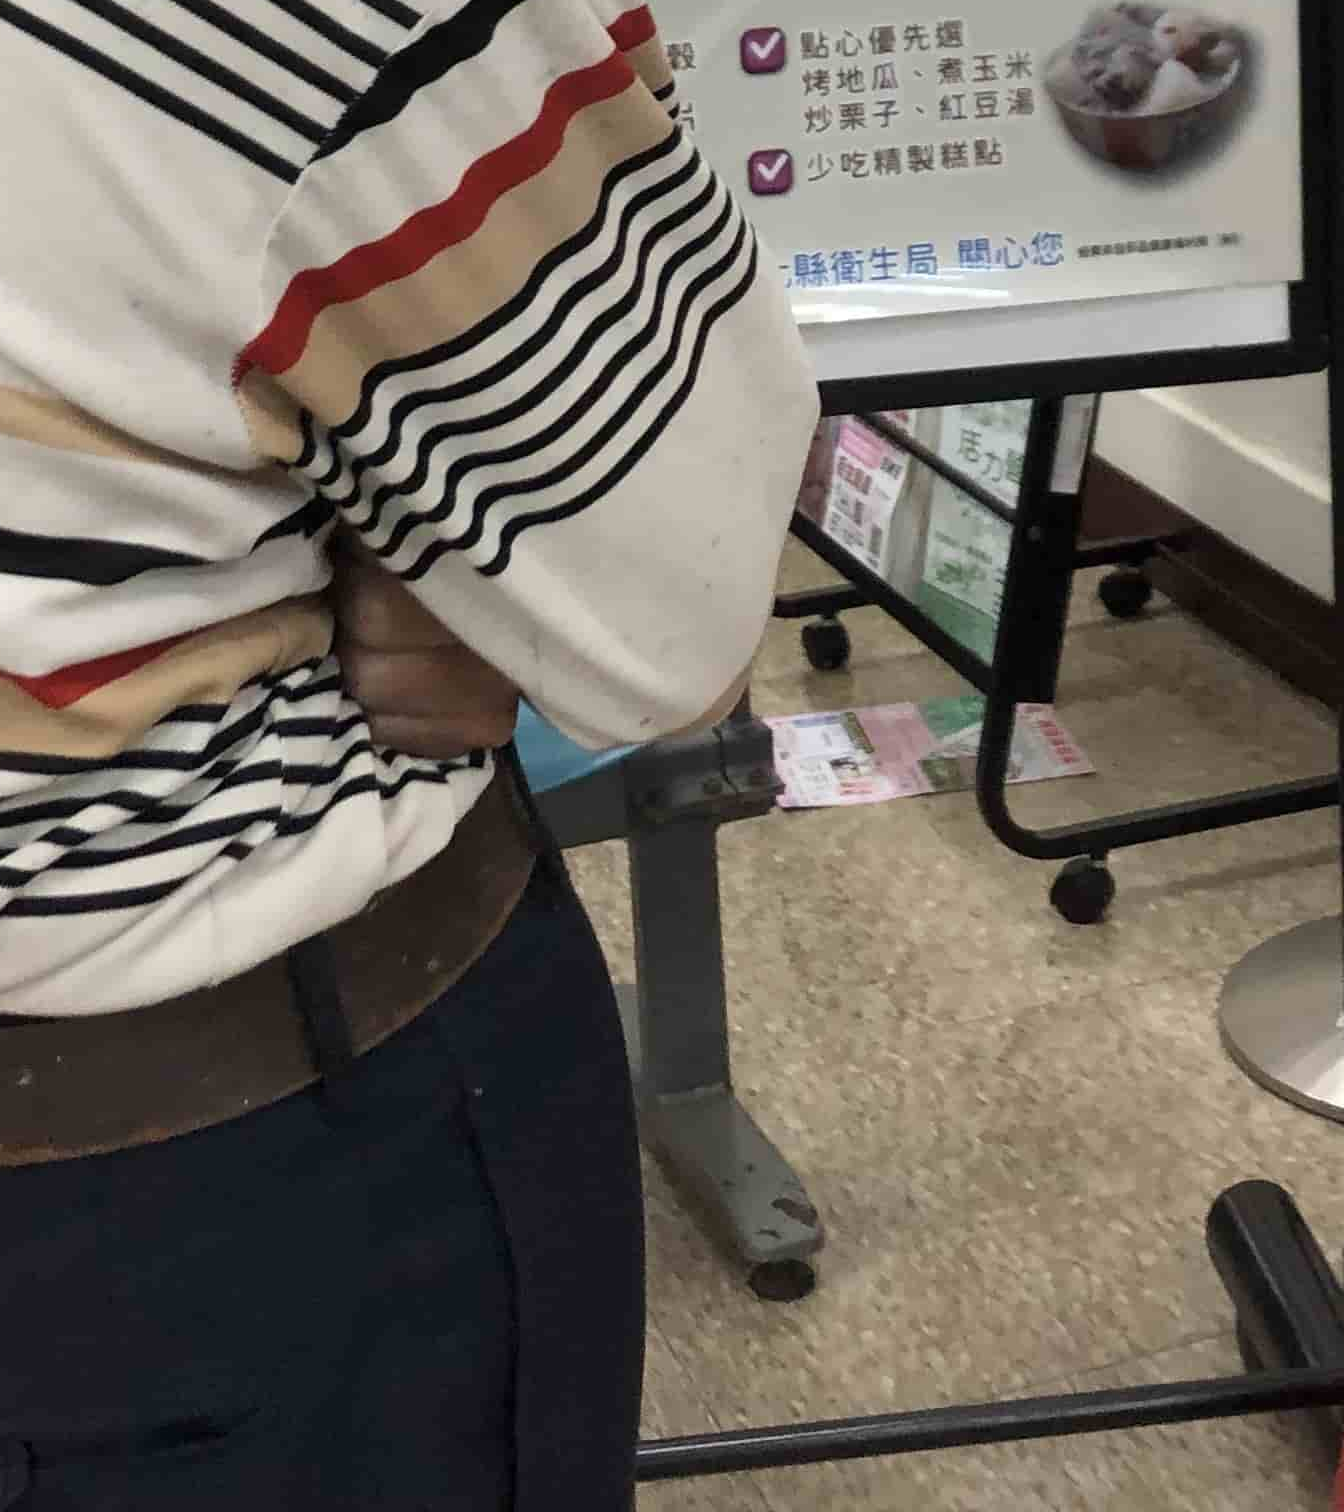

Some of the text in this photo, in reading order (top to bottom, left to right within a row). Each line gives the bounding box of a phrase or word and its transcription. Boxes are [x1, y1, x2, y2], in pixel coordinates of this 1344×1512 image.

[800, 19, 965, 60] 點心優先選
[802, 51, 1033, 97] 烤地瓜、煮玉米
[804, 88, 1036, 134] 炒栗子、紅豆湯
[807, 137, 1004, 183] 少吃精製糕點
[779, 243, 939, 289] 縣衛生局
